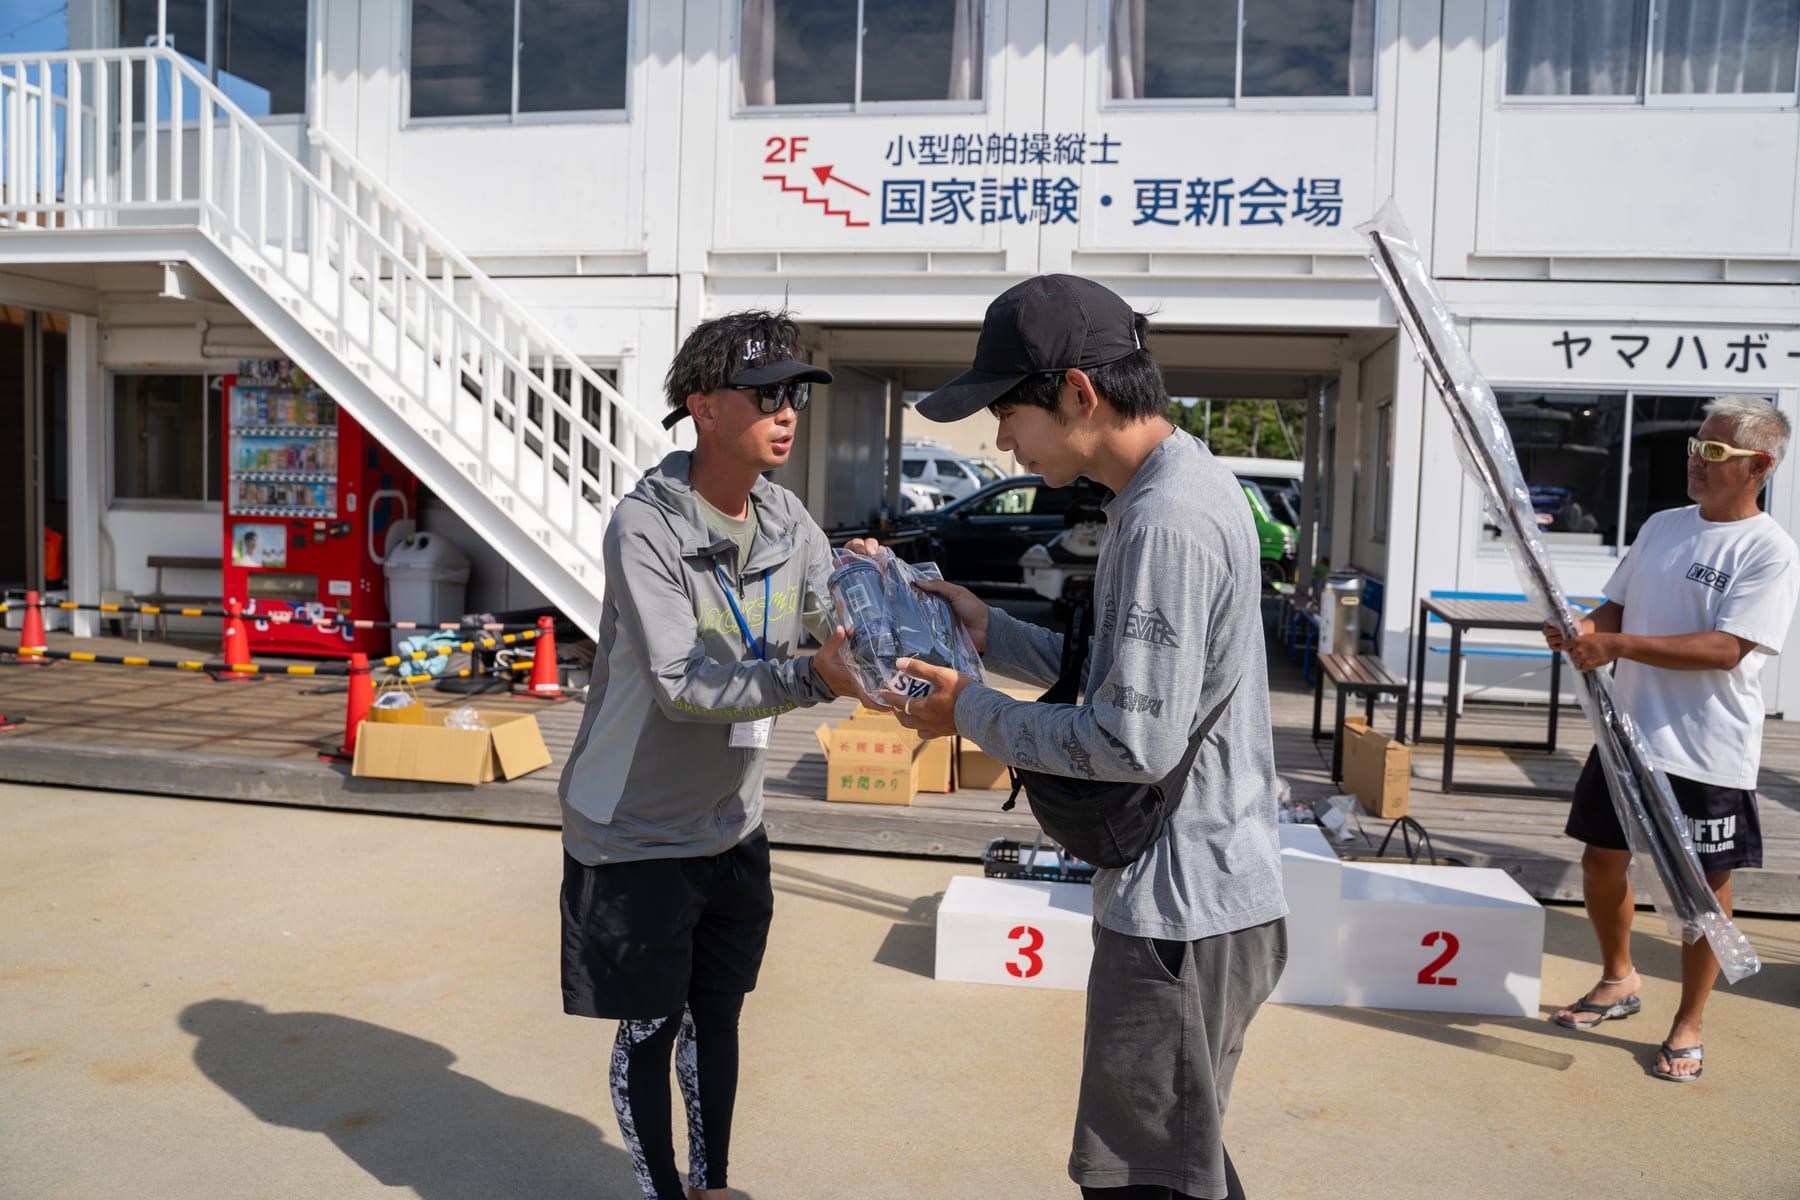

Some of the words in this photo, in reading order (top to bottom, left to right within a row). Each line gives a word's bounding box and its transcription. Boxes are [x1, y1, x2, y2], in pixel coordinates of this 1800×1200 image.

[765, 137, 809, 163] 2F
[885, 133, 1122, 166] 小型船舶操縦士
[881, 176, 1344, 227] 国家試験・更新会場
[1005, 925, 1044, 979] 3
[1417, 930, 1458, 986] 2
